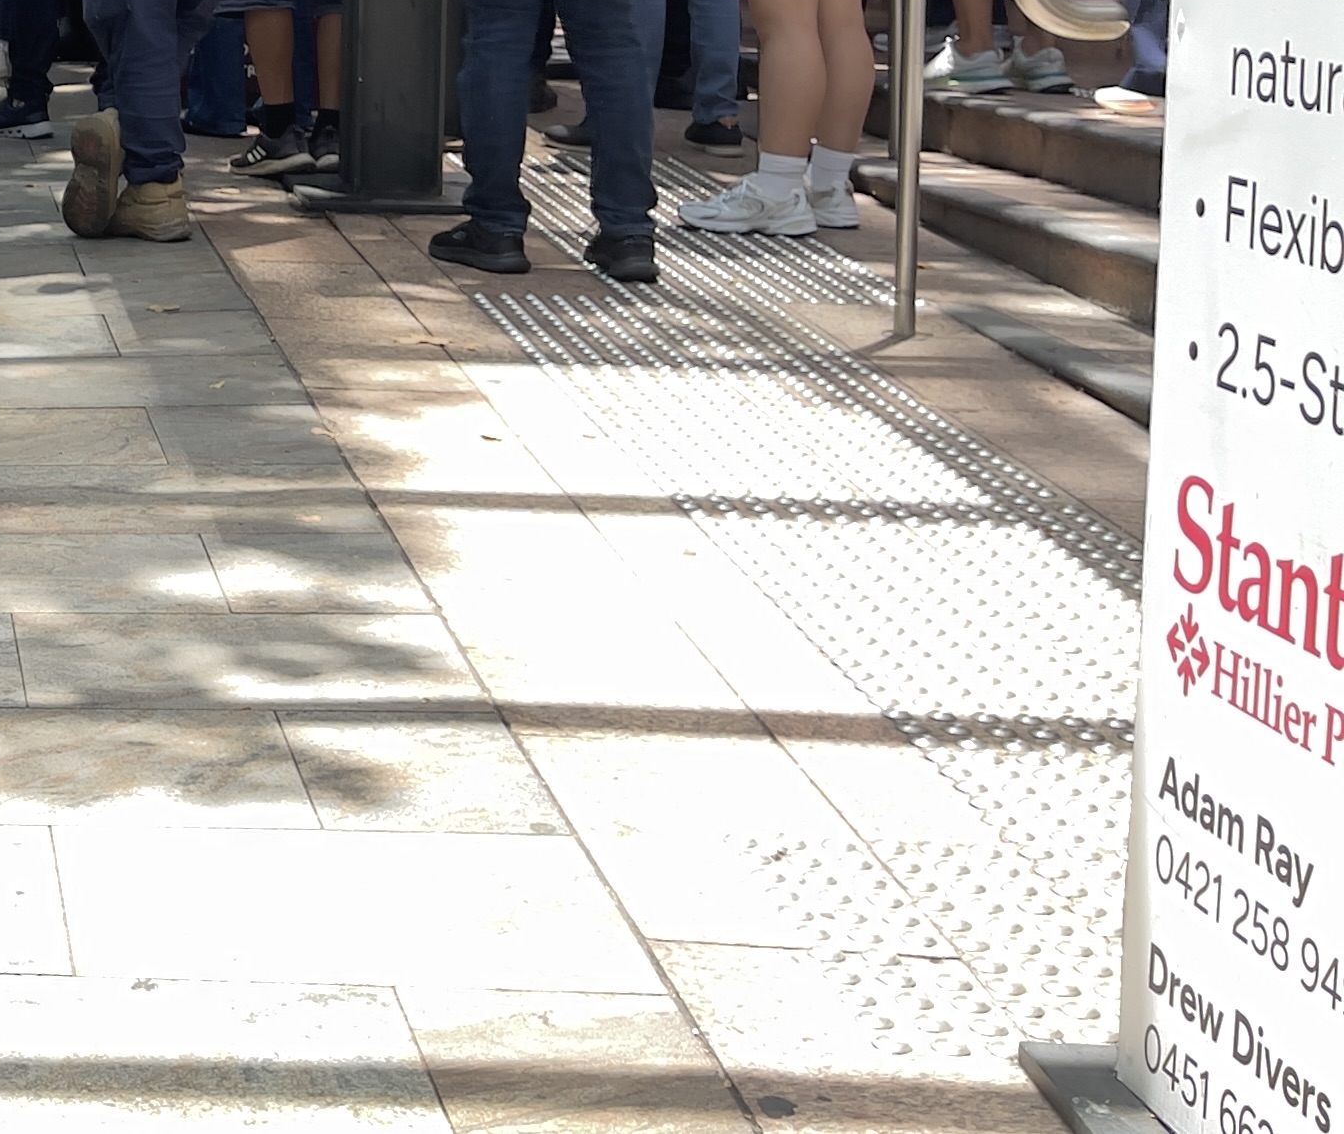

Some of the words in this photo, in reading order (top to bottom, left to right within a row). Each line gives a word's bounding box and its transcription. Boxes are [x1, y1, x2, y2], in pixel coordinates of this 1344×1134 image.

[1230, 40, 1344, 114] natur
[1226, 175, 1344, 274] Flexib
[1216, 322, 1344, 436] 2.5-St
[1173, 475, 1344, 670] Stant
[1211, 641, 1317, 752] Hillier
[1159, 756, 1244, 854] Adam
[1255, 814, 1314, 908] Ray
[1156, 834, 1222, 923] 0421
[1232, 888, 1289, 971] 258
[1300, 937, 1344, 1014] 94
[1144, 1023, 1209, 1119] 0451
[1148, 942, 1224, 1043] Drew
[1233, 1009, 1331, 1134] Divers
